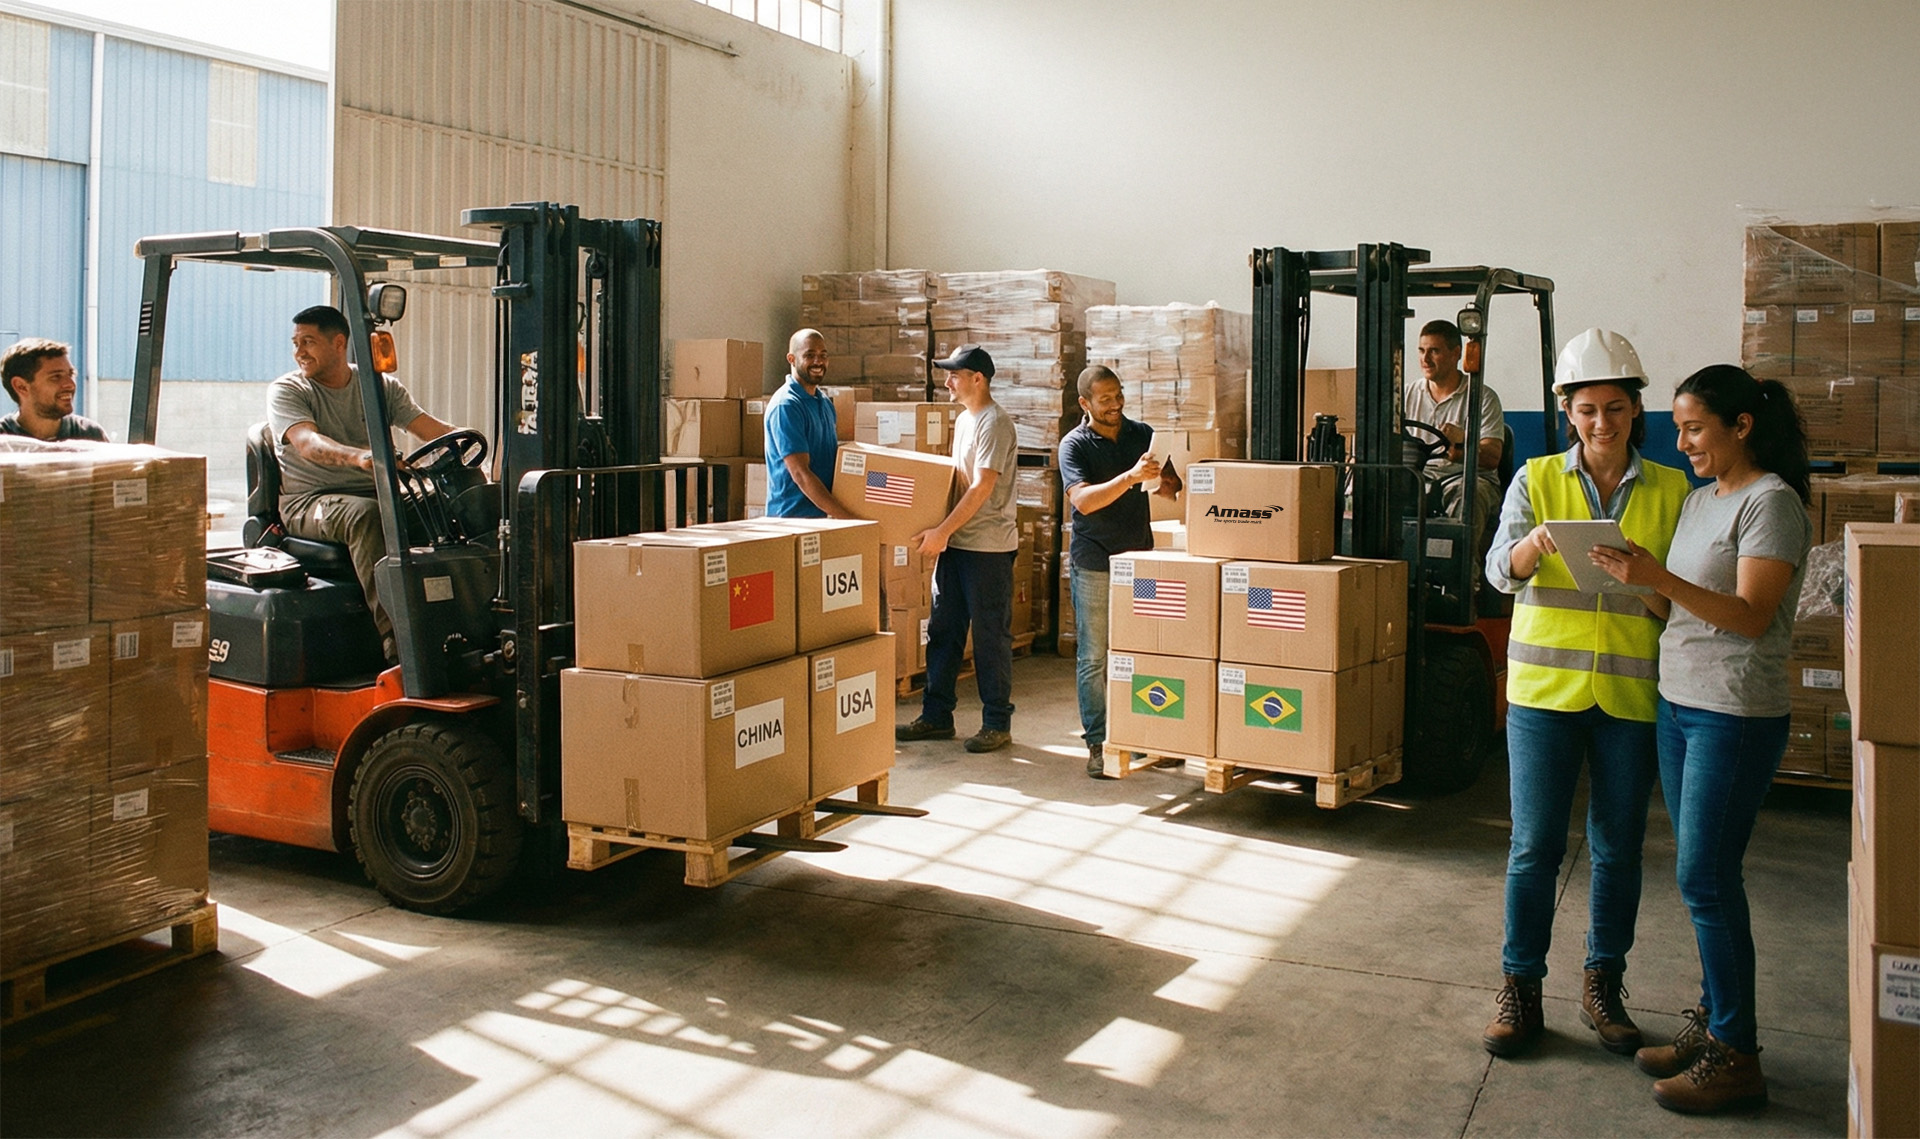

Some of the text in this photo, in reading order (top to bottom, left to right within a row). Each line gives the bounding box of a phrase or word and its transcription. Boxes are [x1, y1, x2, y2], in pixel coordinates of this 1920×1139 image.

[1205, 505, 1273, 519] Amass
[826, 570, 859, 596] USA
[840, 688, 873, 718] USA
[737, 718, 782, 748] CHINA
